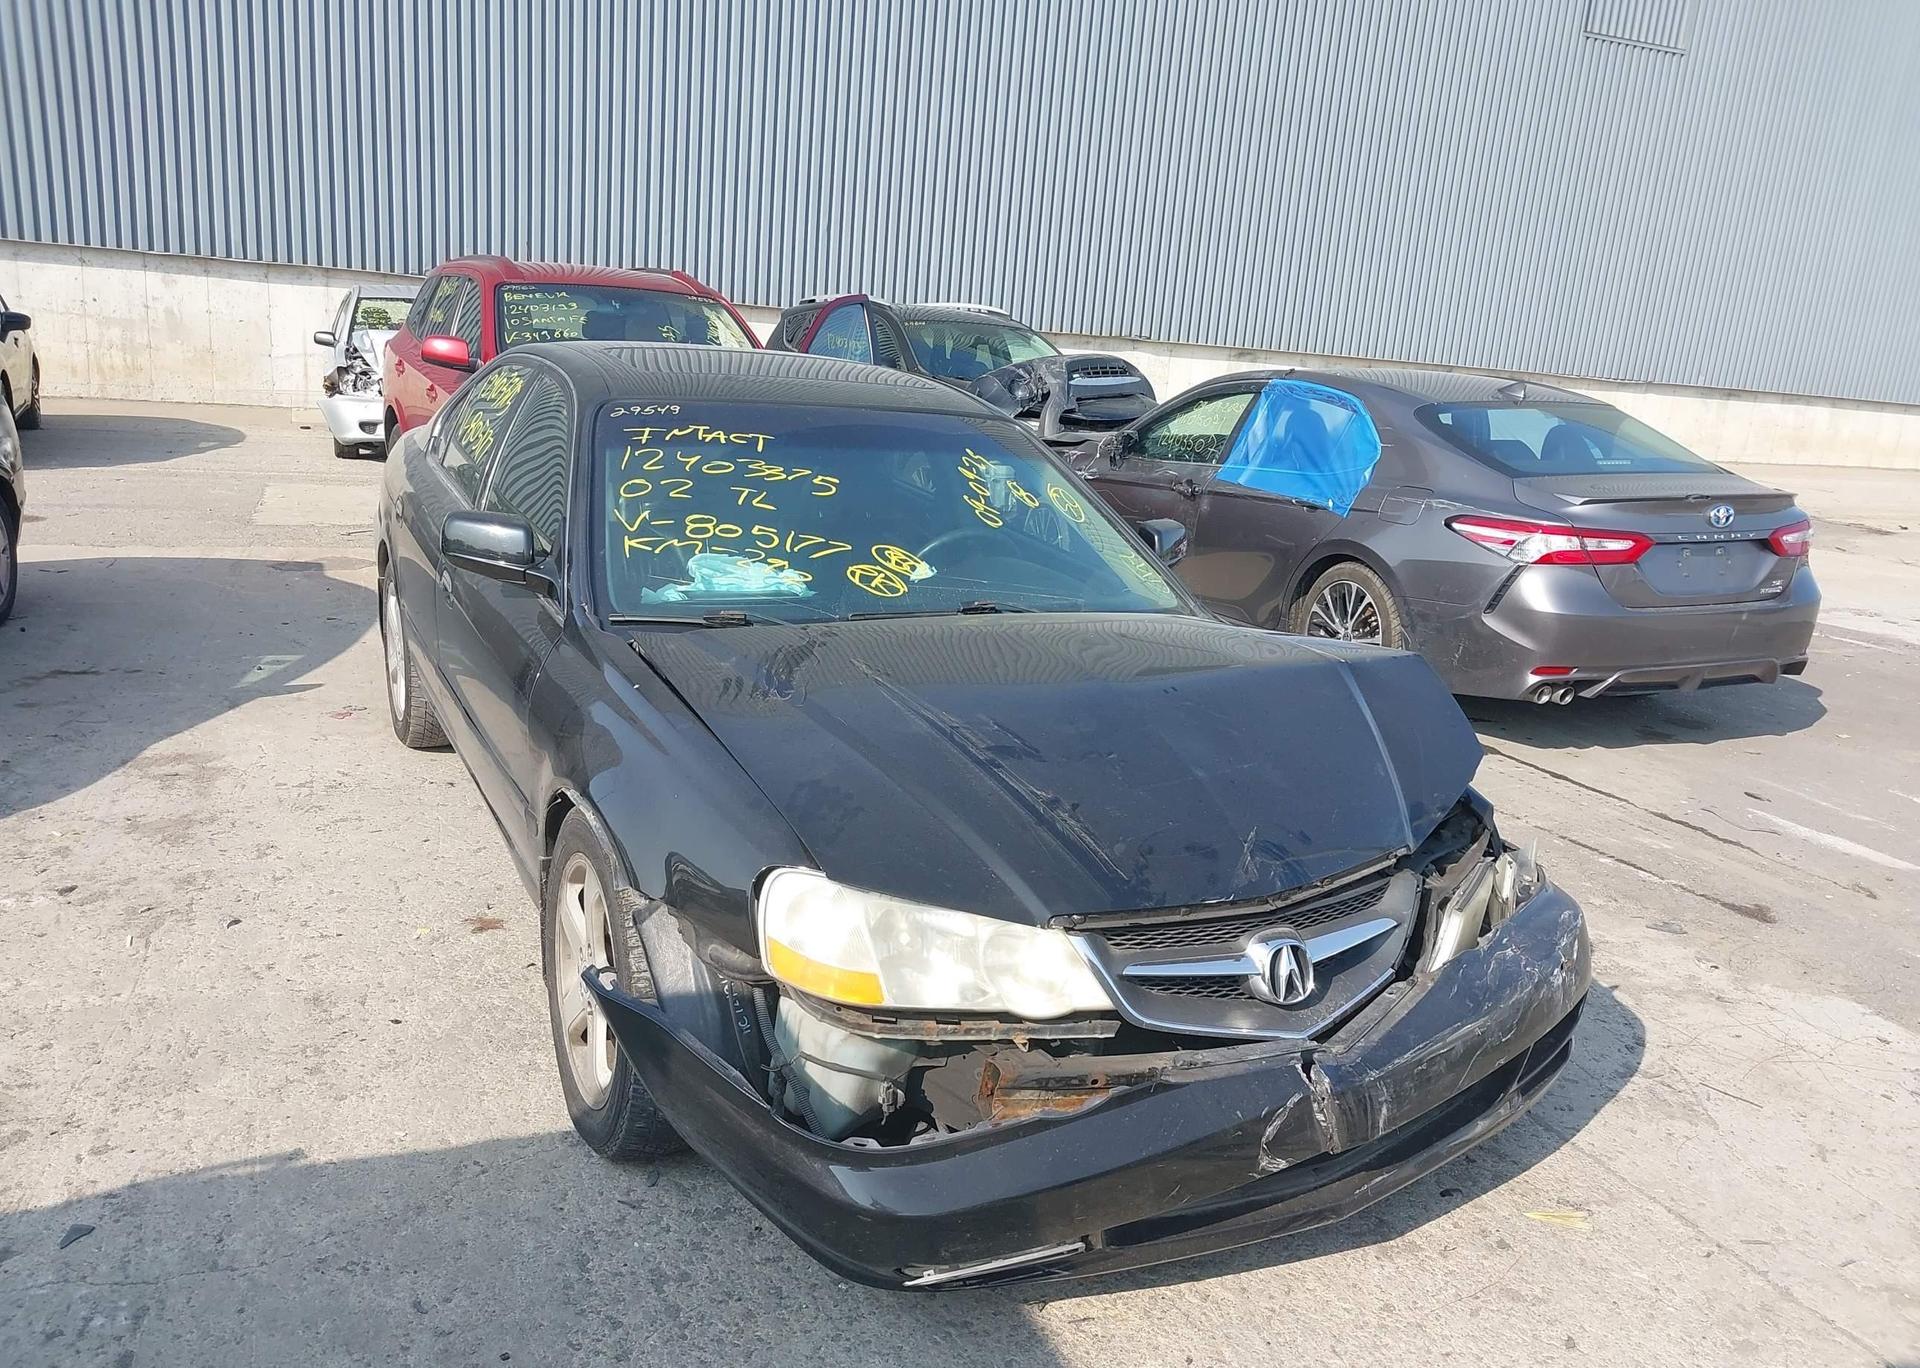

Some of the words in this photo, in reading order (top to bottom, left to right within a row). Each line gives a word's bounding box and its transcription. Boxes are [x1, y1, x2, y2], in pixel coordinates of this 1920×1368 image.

[623, 424, 776, 452] INTACT
[621, 446, 840, 497] 12403875
[620, 478, 694, 499] 02
[730, 486, 777, 510] TL
